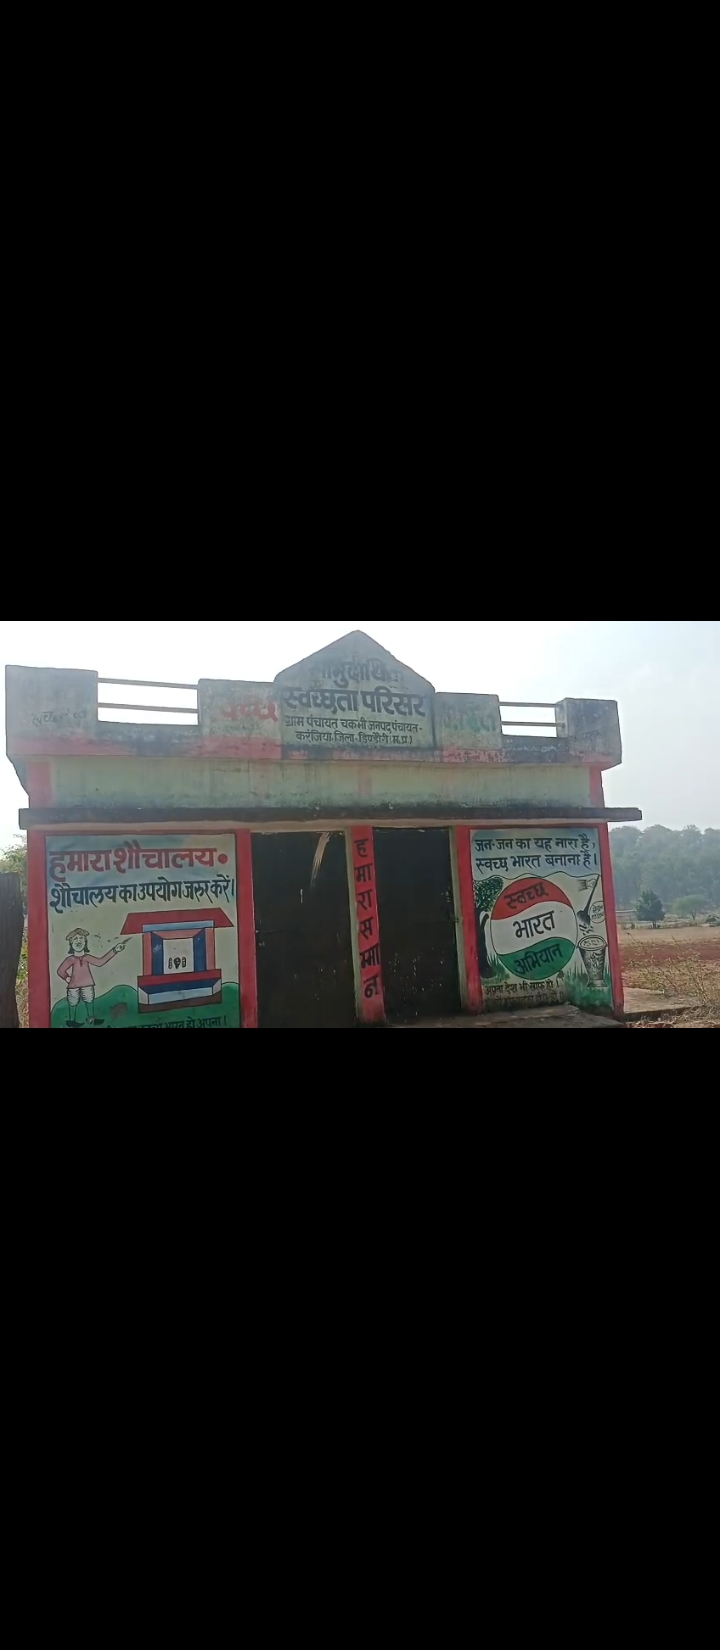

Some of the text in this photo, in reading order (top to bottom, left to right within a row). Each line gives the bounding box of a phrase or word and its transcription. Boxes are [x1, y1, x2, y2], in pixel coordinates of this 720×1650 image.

[283, 685, 426, 717] स्वच्छता परिसर
[285, 714, 304, 727] ग्राम
[306, 714, 338, 730] पंचायत
[514, 838, 531, 849] का
[533, 838, 552, 852] यह
[555, 838, 578, 850] नारा
[50, 839, 217, 882] हमारा शौचालय
[475, 857, 508, 874] स्वच्छ
[510, 855, 541, 870] भारत
[544, 854, 580, 866] बनाना
[50, 882, 119, 913] शौचालय
[119, 884, 137, 903] का
[138, 876, 182, 902] उपयोग
[504, 881, 549, 909] स्वच्छ
[512, 910, 555, 938] भारत
[514, 943, 563, 975] अभियान
